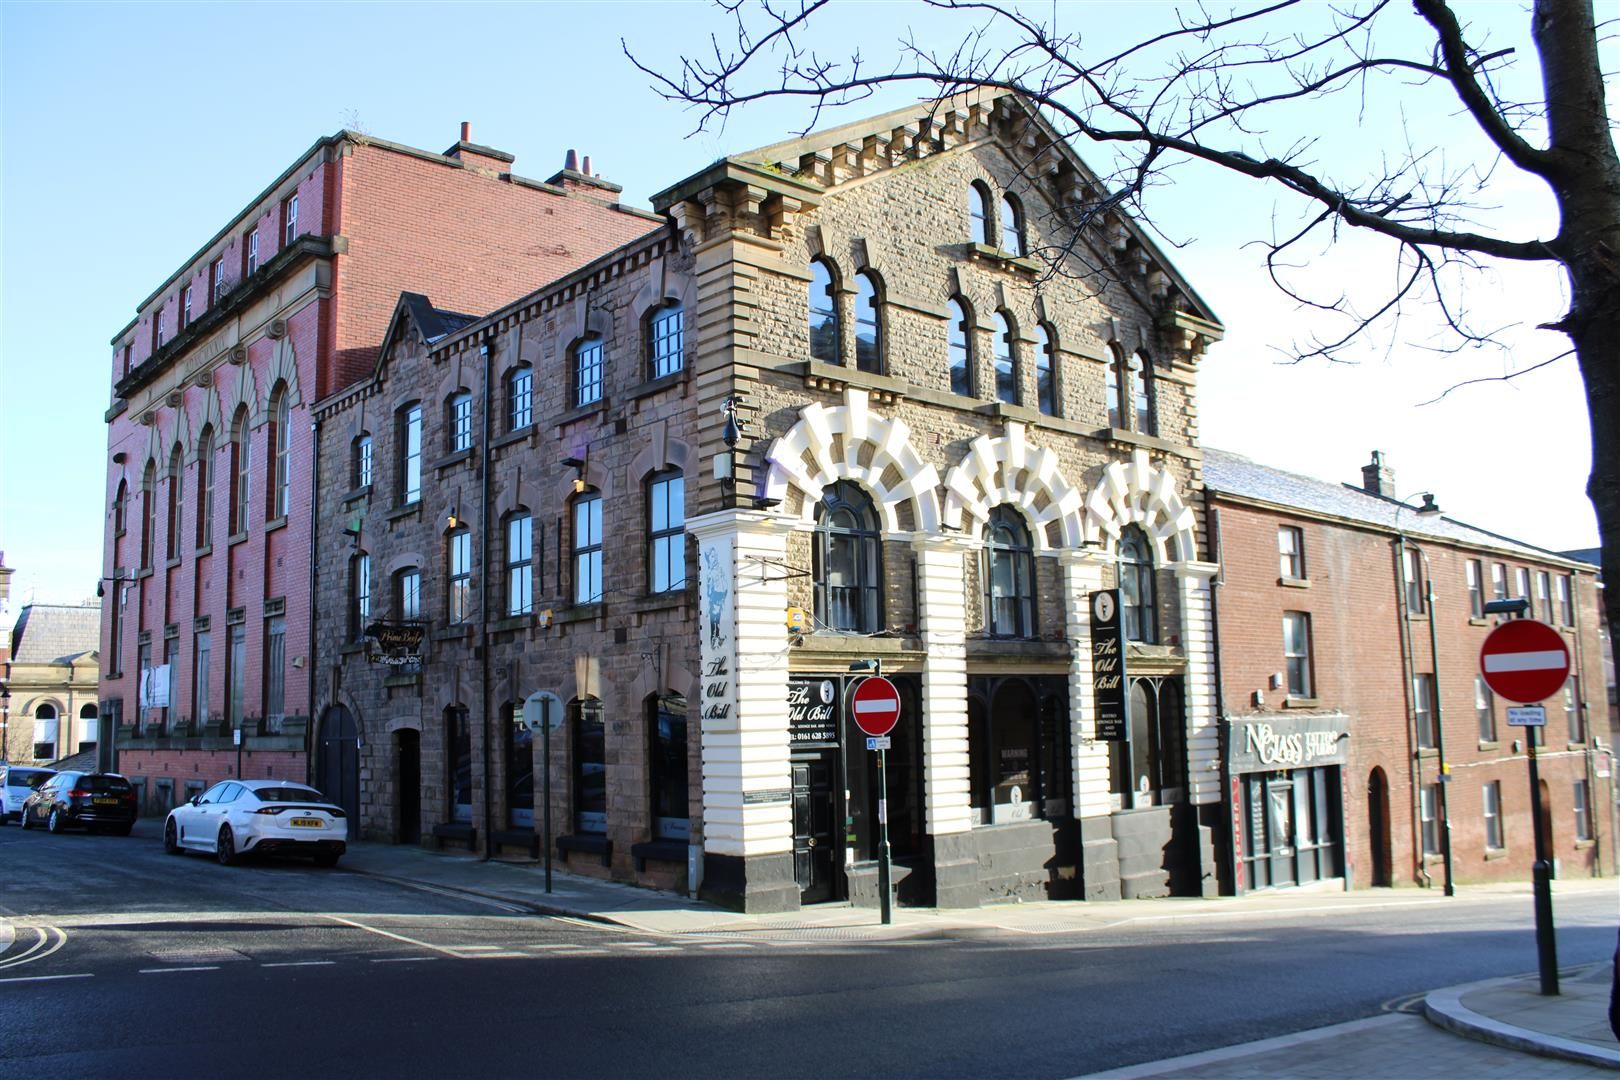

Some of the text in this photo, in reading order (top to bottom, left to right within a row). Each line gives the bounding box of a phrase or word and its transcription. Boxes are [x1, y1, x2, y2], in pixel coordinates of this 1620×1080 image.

[1093, 638, 1117, 656] The
[705, 656, 728, 677] The
[1095, 658, 1118, 673] Old
[706, 681, 728, 698] Old
[1093, 675, 1121, 690] Bill
[789, 686, 810, 705] The
[704, 703, 731, 720] Bill
[807, 704, 834, 721] Bill
[811, 732, 822, 740] 628
